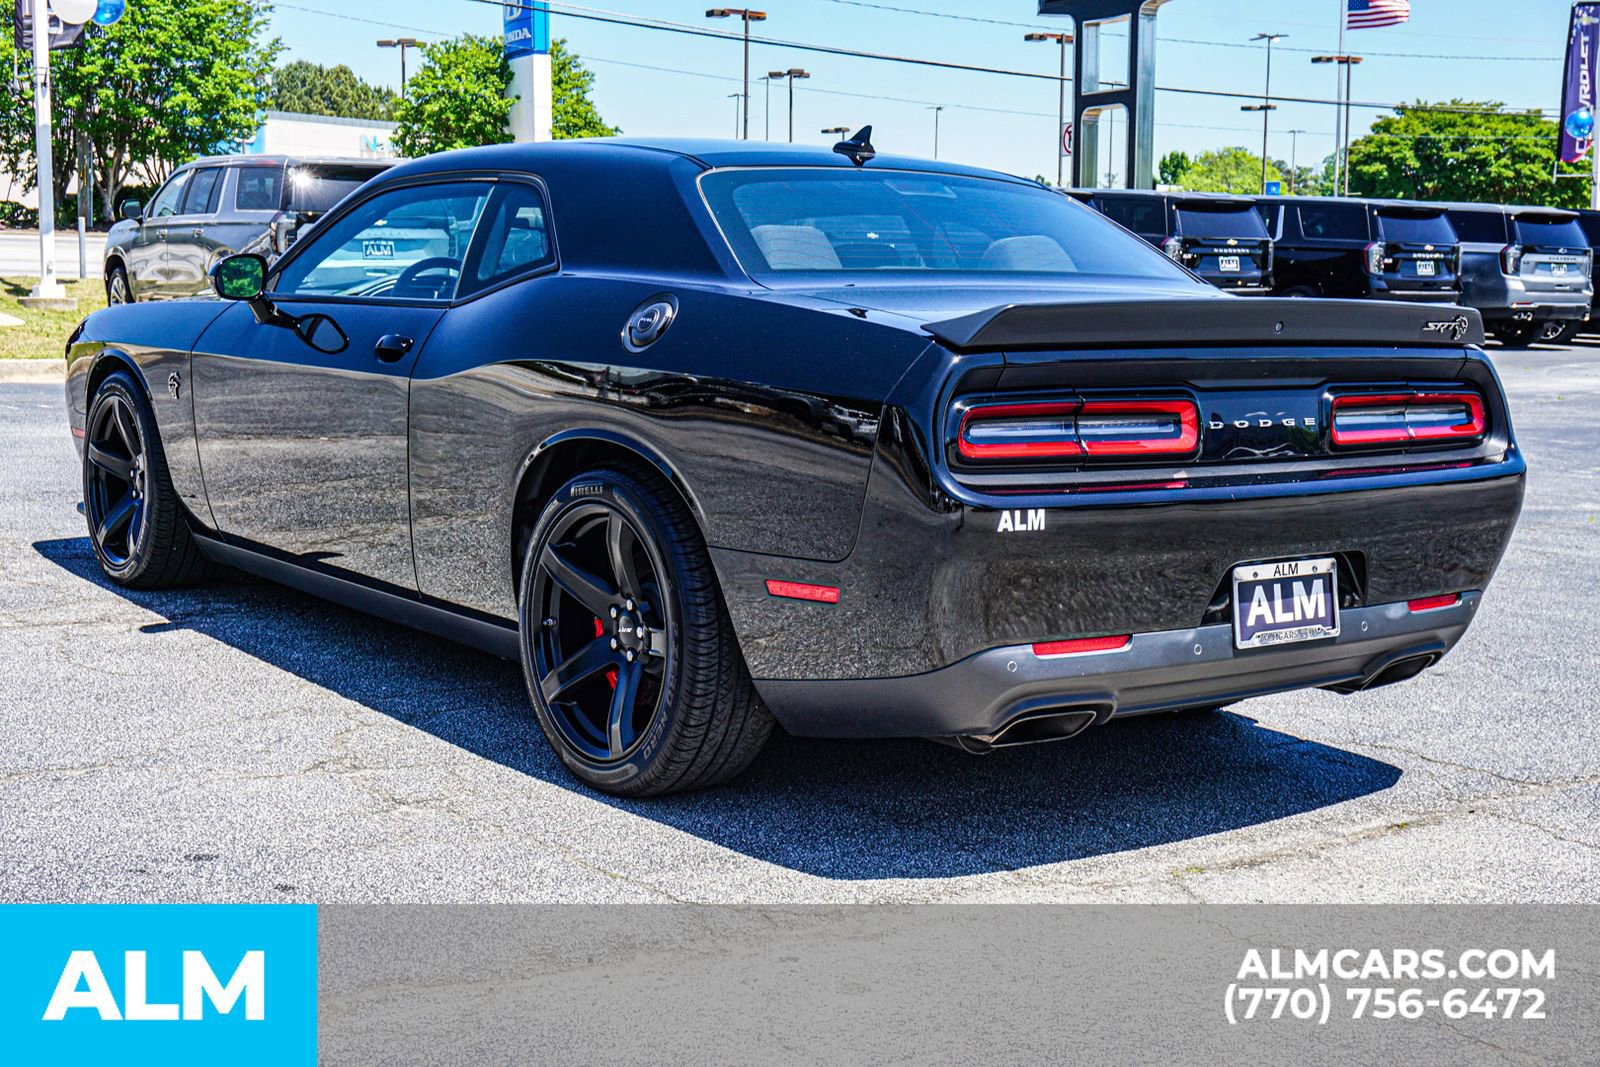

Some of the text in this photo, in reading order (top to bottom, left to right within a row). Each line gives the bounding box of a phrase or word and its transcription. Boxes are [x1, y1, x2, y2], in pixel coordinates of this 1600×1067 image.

[504, 27, 532, 43] ONDA
[366, 244, 391, 256] ALM
[1422, 322, 1459, 333] SRT
[1208, 417, 1316, 430] DODGE
[570, 486, 603, 497] PIRELLI
[997, 508, 1045, 532] ALM
[1273, 562, 1299, 577] ALM
[1246, 579, 1326, 627] ALM
